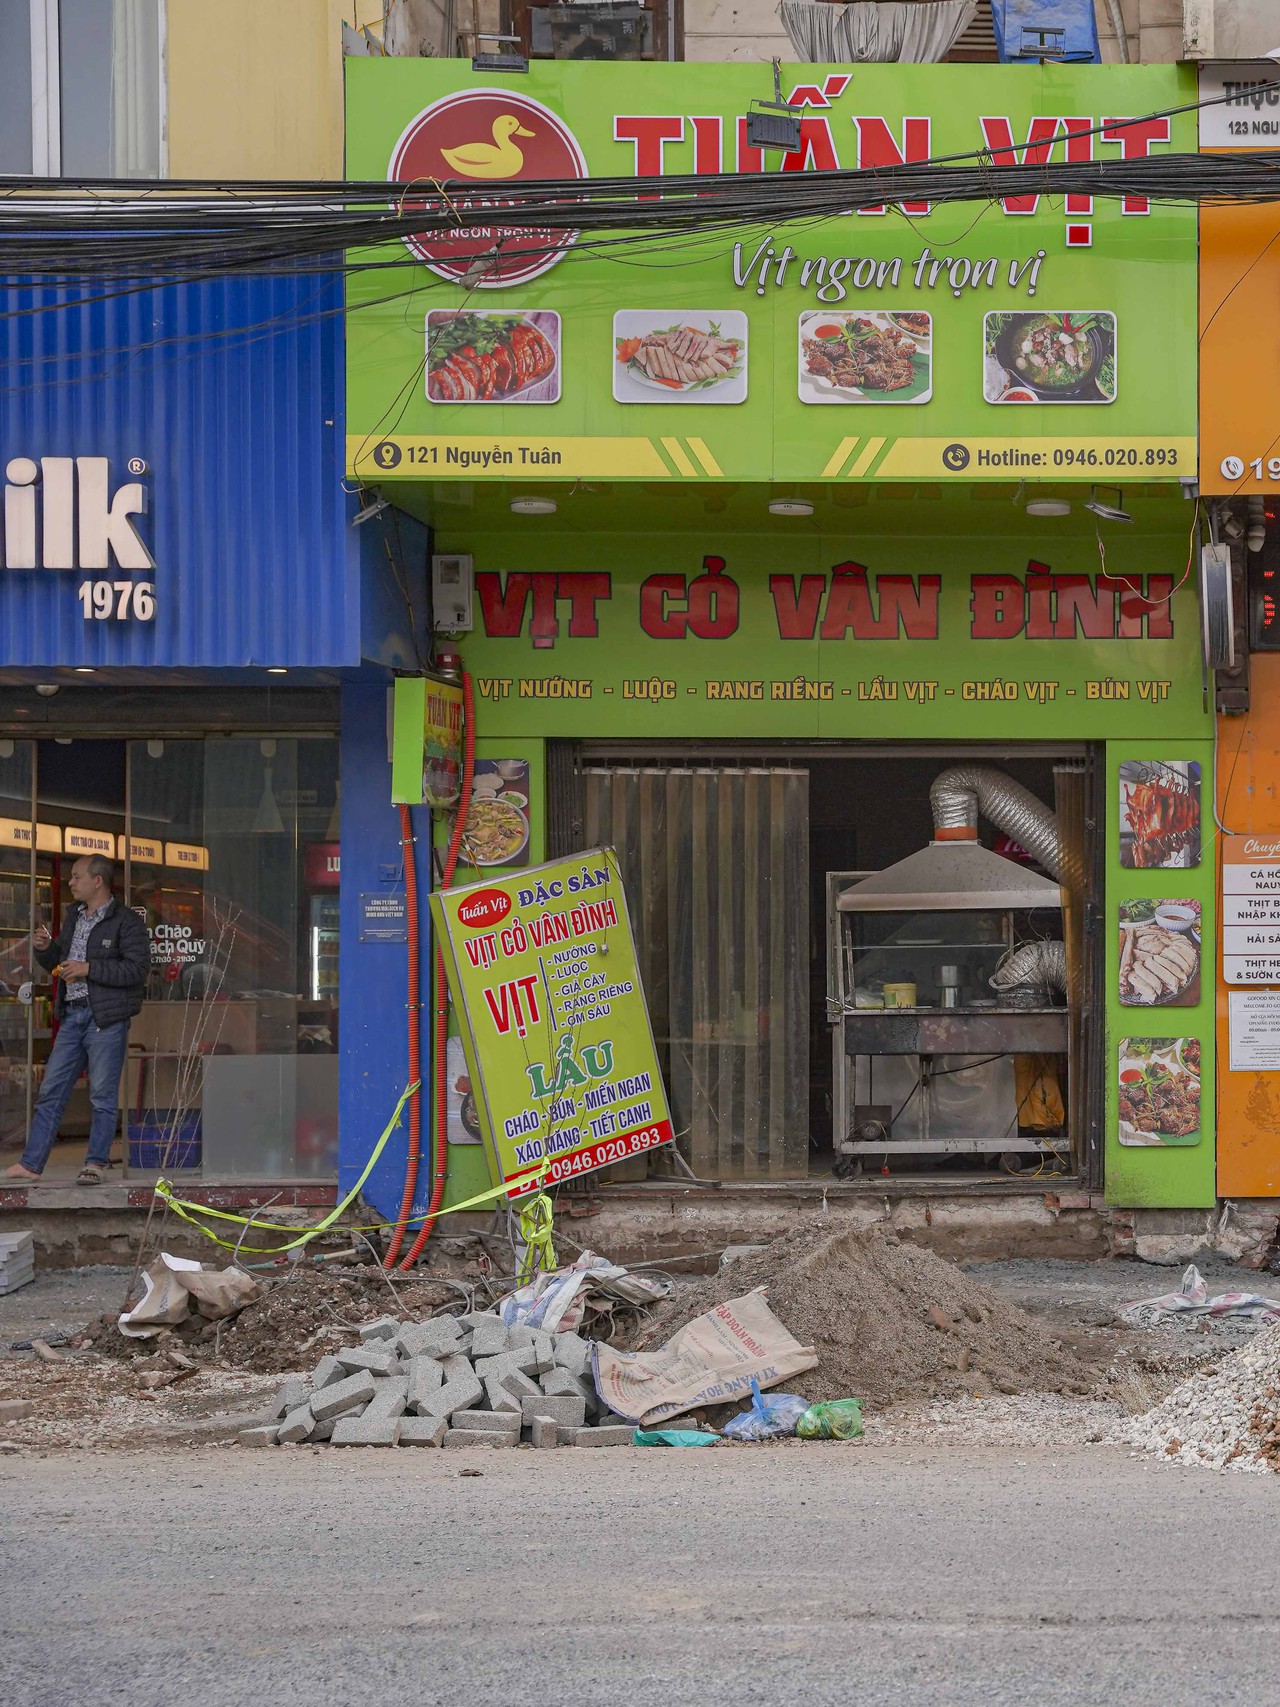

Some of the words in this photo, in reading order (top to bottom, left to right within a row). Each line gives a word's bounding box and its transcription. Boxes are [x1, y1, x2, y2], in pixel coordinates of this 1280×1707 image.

[1228, 121, 1249, 136] 123
[978, 116, 1171, 247] VỊT
[733, 236, 797, 296] Vịt
[801, 255, 902, 302] ngon
[912, 247, 999, 298] trọn
[1007, 249, 1047, 297] vị
[407, 446, 439, 464] 121
[445, 443, 513, 469] Nguyễn
[518, 446, 563, 465] Tuân
[977, 448, 1048, 467] Hotline:
[1053, 448, 1179, 467] 0946.020.893
[4, 457, 156, 569] ilk
[79, 581, 156, 621] 1976
[475, 572, 612, 649] VỊT
[639, 555, 741, 640] CỎ
[769, 560, 942, 640] VÂN
[970, 559, 1175, 640] ĐÌNH
[477, 678, 513, 702] VỊT
[519, 675, 592, 700] NƯỚNG
[622, 676, 677, 702] LUỘC
[706, 680, 763, 700] RANG
[771, 674, 834, 701] RIỀNG
[858, 675, 898, 700] LẨU
[904, 681, 938, 705] VỊT
[962, 677, 1019, 701] CHÁO
[1023, 681, 1059, 704] VỊT
[1085, 677, 1130, 701] BÚN
[1136, 681, 1171, 704] VỊT
[1250, 869, 1265, 879] CÁ
[518, 881, 564, 908] ĐẶC
[568, 867, 612, 897] SẢN
[460, 903, 489, 921] Tuấn
[488, 897, 508, 914] Vịt
[1237, 909, 1267, 921] NHẬP
[1247, 899, 1271, 910] THỊT
[464, 932, 499, 970] VỊT
[499, 916, 529, 955] CỎ
[531, 905, 571, 951] VÂN
[571, 899, 620, 939] ĐÌNH
[1246, 933, 1265, 943] HẢI
[177, 955, 196, 963] 21h30
[553, 942, 597, 965] NƯỚNG
[1245, 960, 1267, 969] THỊT
[556, 961, 588, 980] LUỘC
[1236, 971, 1243, 979] &
[1245, 970, 1273, 979] SƯỜN
[482, 974, 540, 1040] VỊT
[563, 991, 597, 1011] RANG
[567, 1012, 586, 1027] OM
[524, 1033, 616, 1101] LẨU
[504, 1109, 540, 1140] CHÁO
[549, 1098, 577, 1123] BÚN
[584, 1078, 619, 1108] MIẾN
[618, 1072, 653, 1098] NGAN
[514, 1138, 544, 1167] XÁO
[547, 1124, 582, 1156] MĂNG
[589, 1115, 620, 1142] TIẾT
[618, 1101, 653, 1131] CANH
[551, 1128, 662, 1180] 0946.020.893
